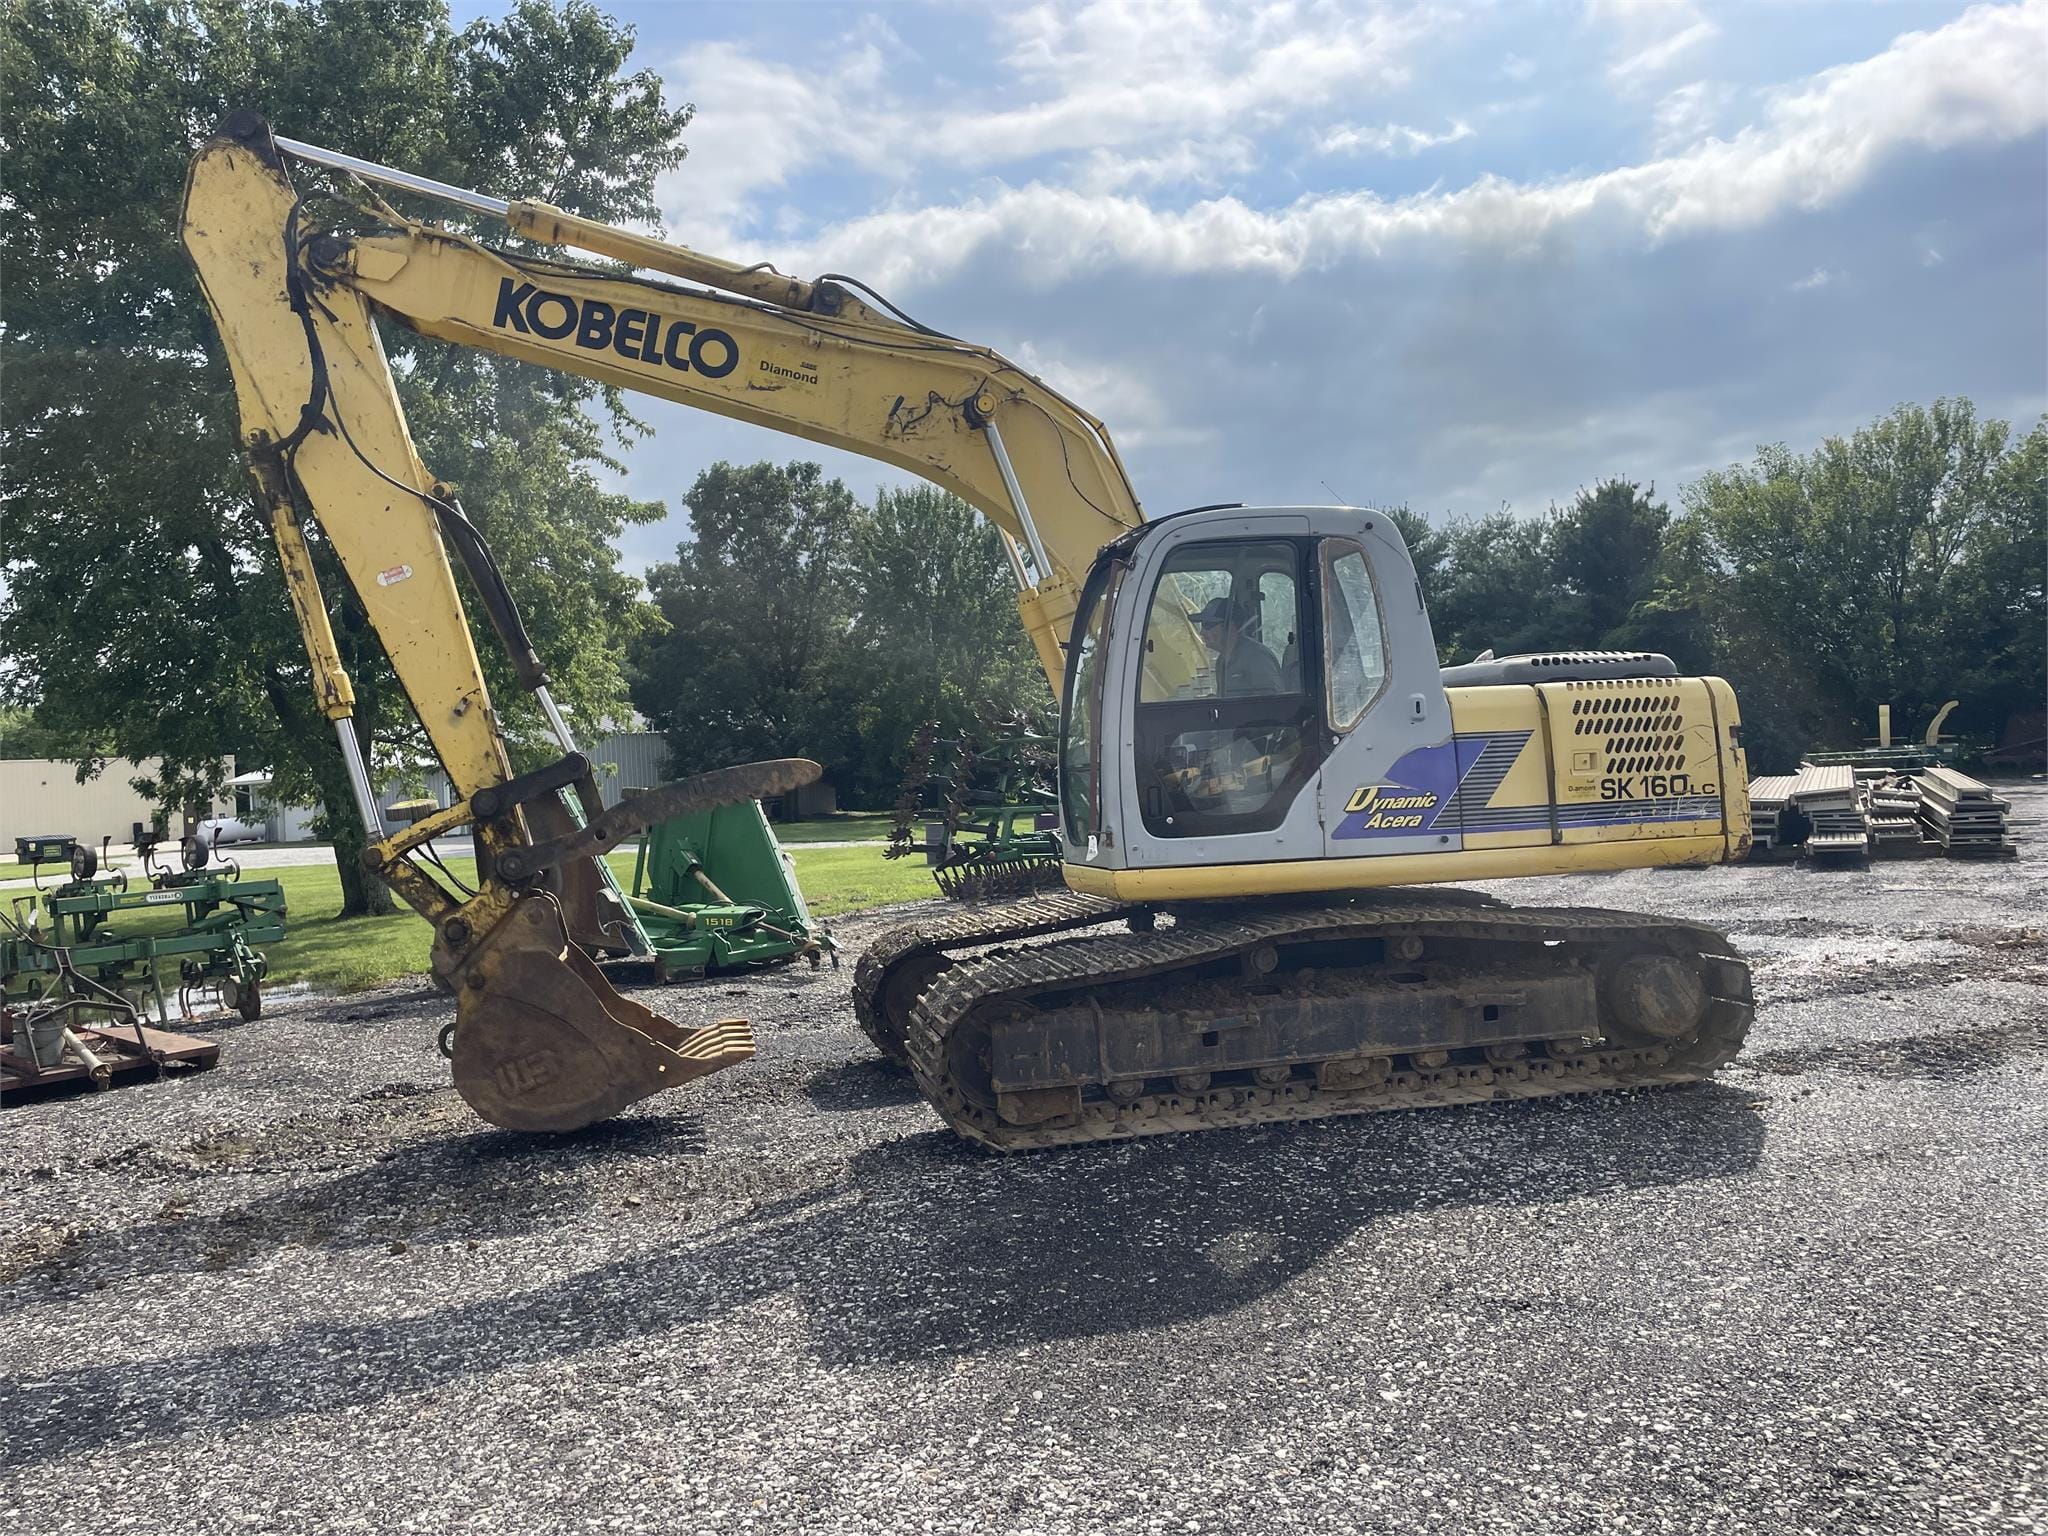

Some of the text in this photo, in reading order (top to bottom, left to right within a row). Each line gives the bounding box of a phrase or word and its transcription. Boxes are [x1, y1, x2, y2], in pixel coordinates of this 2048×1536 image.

[493, 277, 739, 378] KOBELCO
[760, 360, 818, 385] Diamond
[1344, 786, 1438, 815] Dynamic
[1600, 777, 1634, 800] SK
[1363, 812, 1423, 829] Acera
[705, 918, 733, 926] 1518
